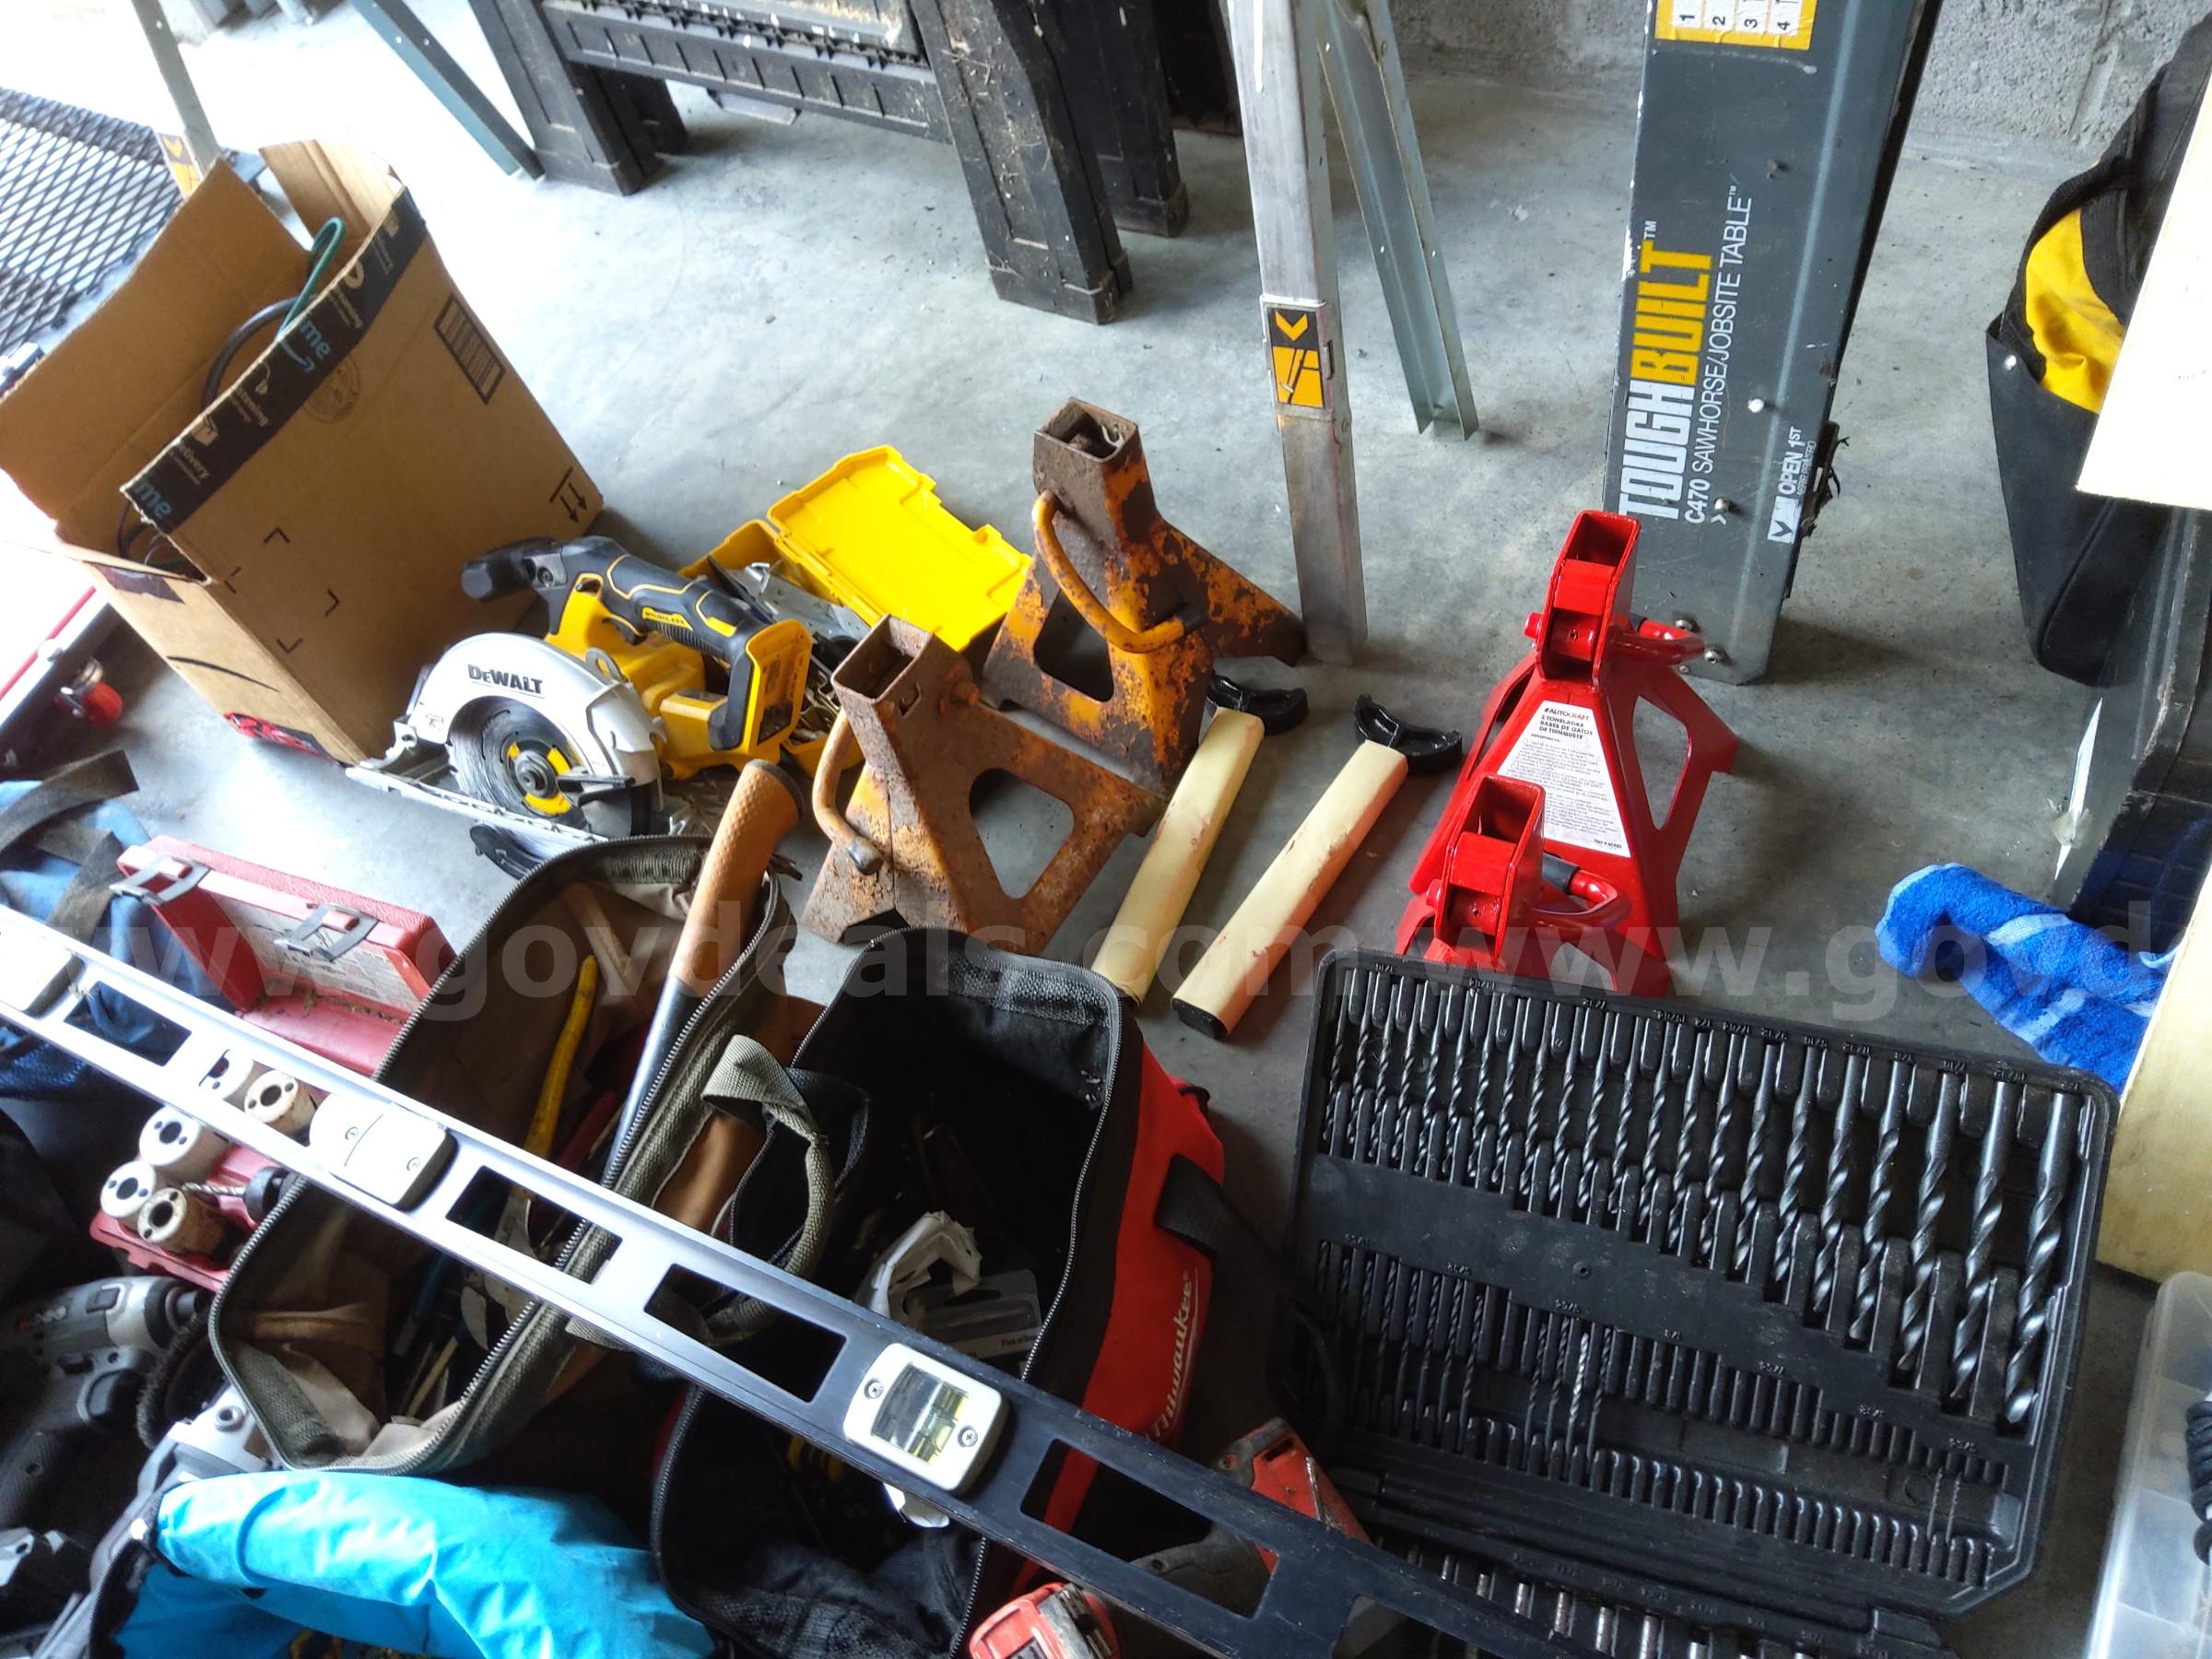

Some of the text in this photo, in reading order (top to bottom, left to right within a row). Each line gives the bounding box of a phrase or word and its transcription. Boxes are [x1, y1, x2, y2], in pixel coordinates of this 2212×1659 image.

[1679, 13, 1695, 22] 1
[1712, 16, 1726, 26] 2
[1744, 18, 1758, 29] 3
[1777, 20, 1791, 31] 4
[1692, 271, 1741, 475] SAWHORSE/JOBSITE
[1778, 425, 1806, 496] OPEN 1ST
[1685, 478, 1711, 525] C470
